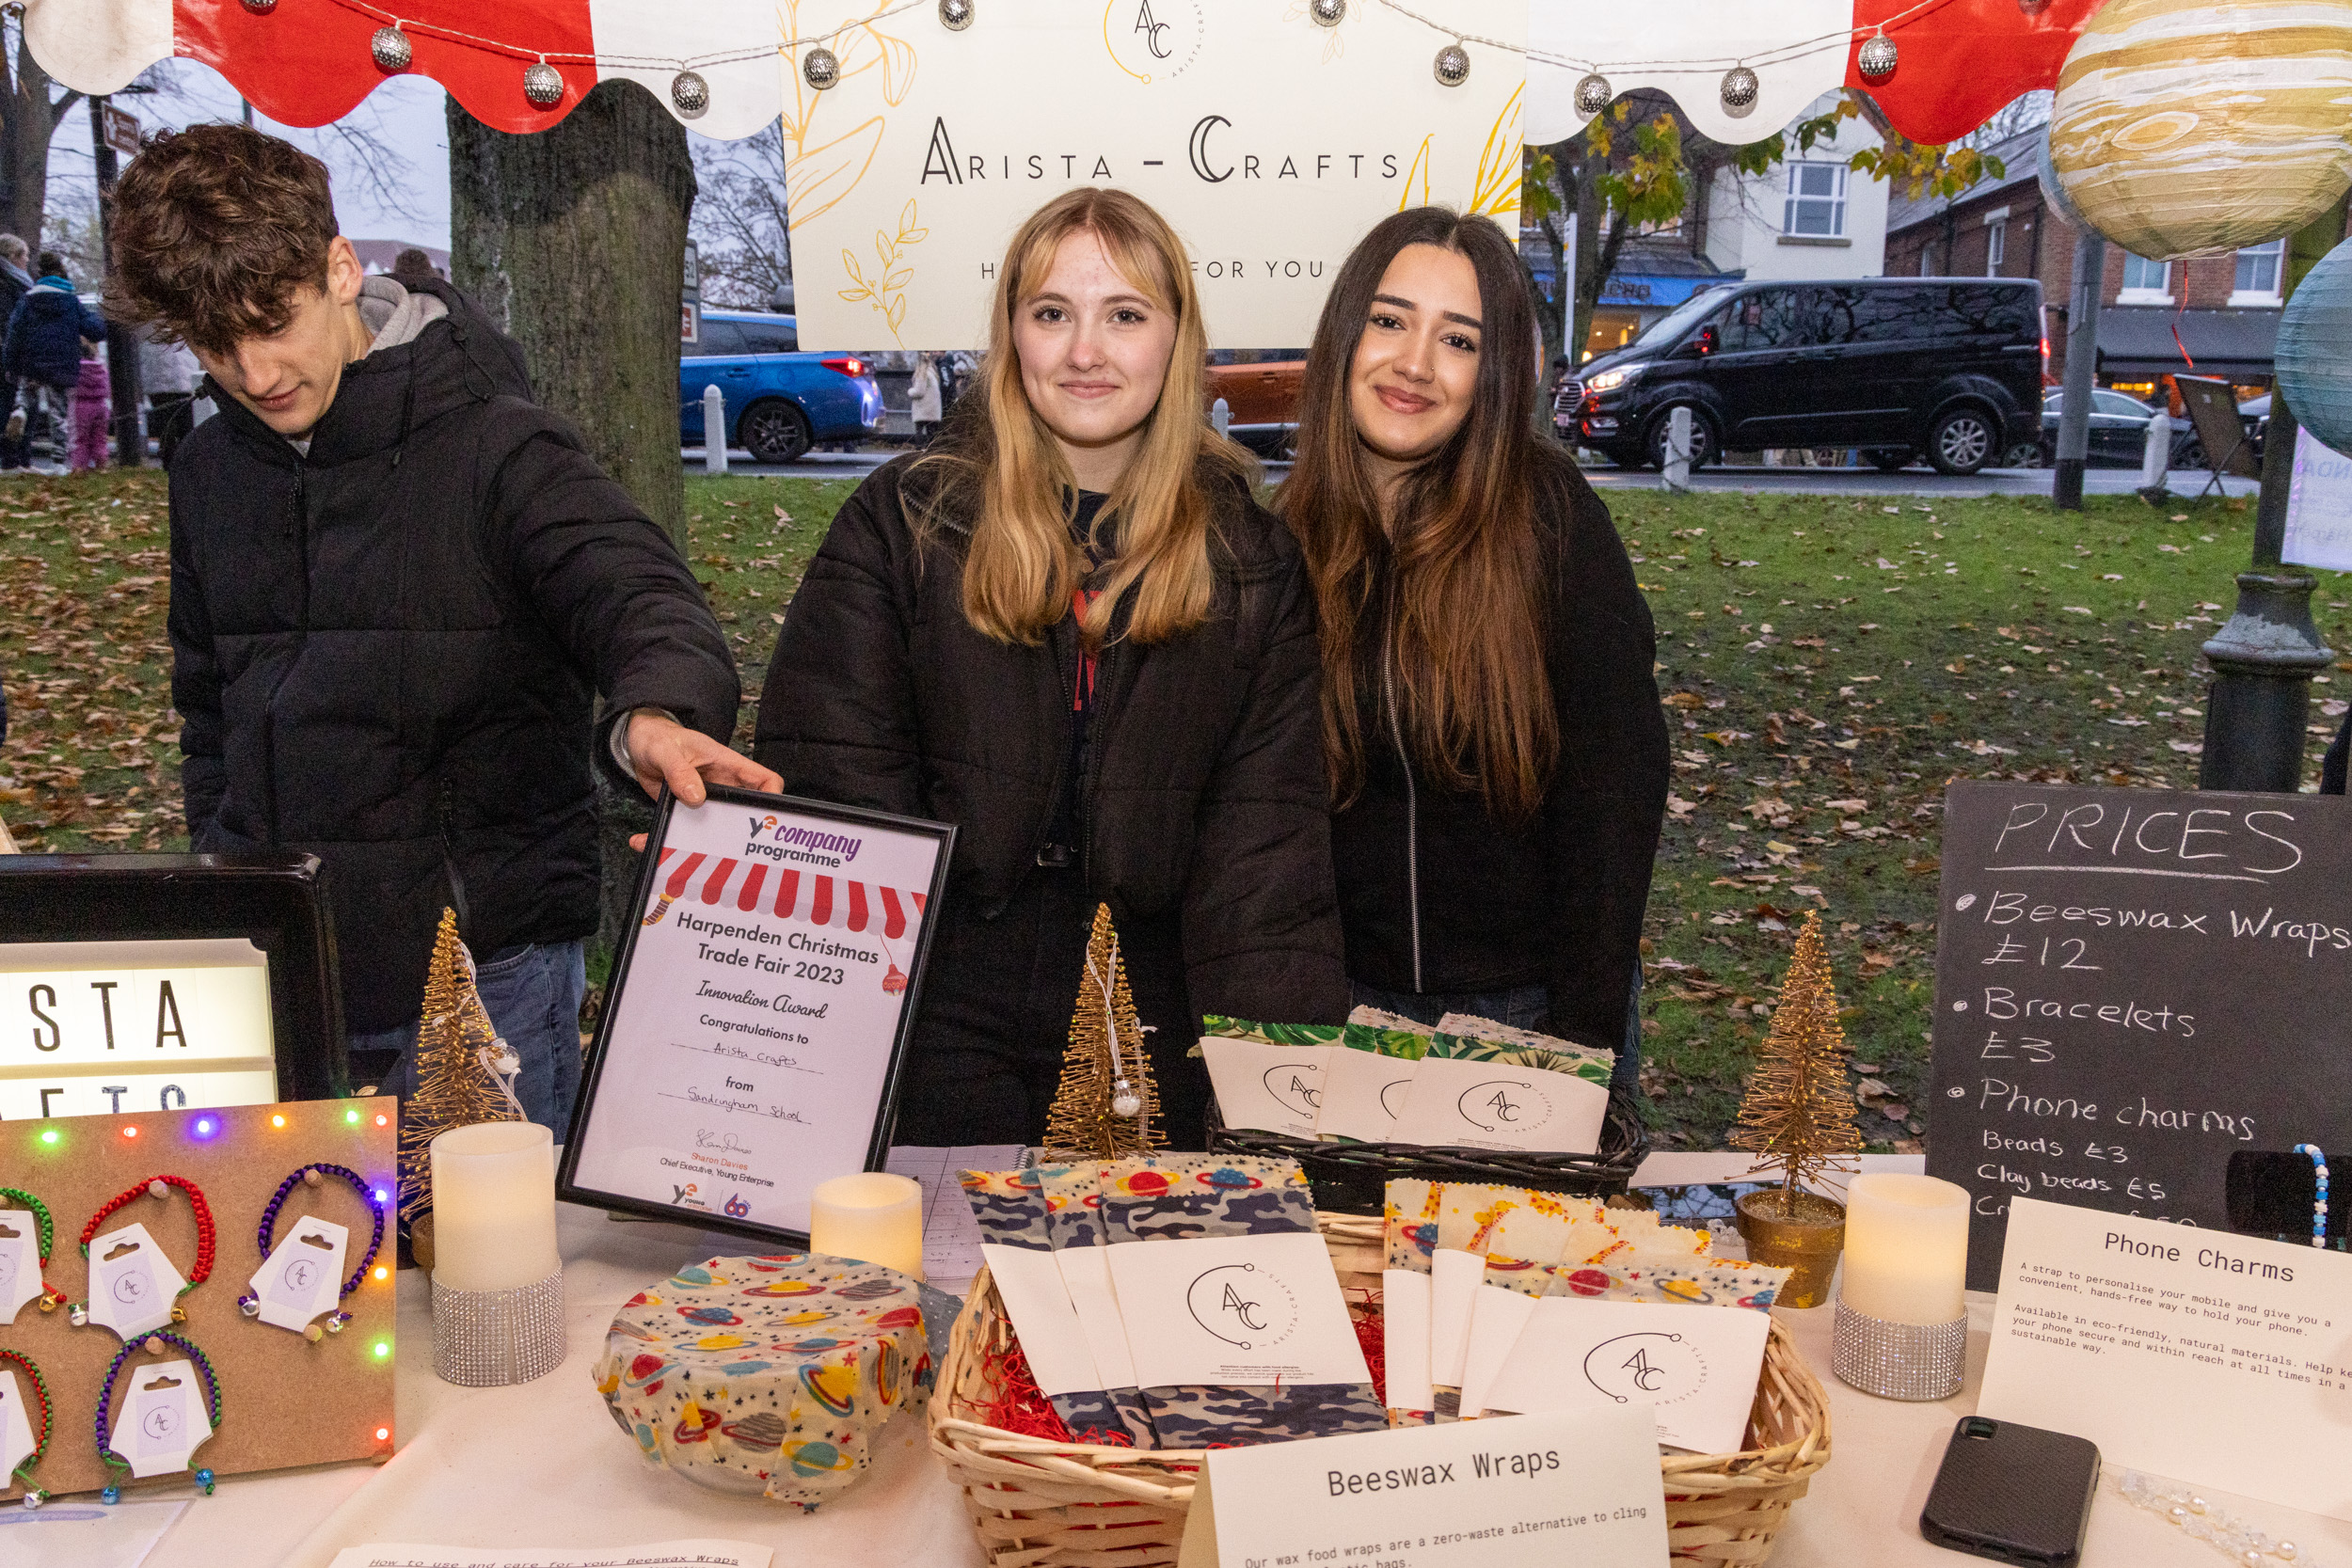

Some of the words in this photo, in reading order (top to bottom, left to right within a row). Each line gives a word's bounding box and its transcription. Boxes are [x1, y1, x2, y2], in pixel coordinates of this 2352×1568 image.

[1171, 0, 1204, 78] ARISTA-CRAF
[919, 116, 1112, 184] ARISTA
[1188, 115, 1398, 183] CRAFTS
[1265, 261, 1323, 278] YOU
[745, 842, 841, 868] programme
[774, 825, 862, 862] company
[1995, 802, 2302, 873] PRICES
[676, 911, 782, 945] Harpenden
[788, 932, 879, 964] Christmas
[1983, 891, 2207, 935] Beeswax
[2230, 908, 2352, 958] Wraps
[698, 943, 749, 967] Trade
[755, 953, 790, 974] Fair
[794, 961, 844, 985] 2023
[1980, 934, 2103, 971] £12
[28, 980, 187, 1052] STA
[695, 980, 769, 1008] Innovation
[772, 994, 829, 1019] Award
[1984, 987, 2195, 1037] Bracelets
[699, 1014, 794, 1042] Congratulations
[797, 1033, 809, 1044] to
[1980, 1031, 2056, 1063] £3
[713, 1042, 748, 1058] Arista
[756, 1053, 797, 1067] Crafts
[725, 1076, 755, 1092] from
[770, 1105, 803, 1122] School
[1979, 1078, 2098, 1121] Phone
[2117, 1097, 2255, 1140] charms
[691, 1152, 720, 1165] Sharon
[721, 1158, 748, 1171] Davies
[1983, 1129, 2063, 1156] Beads
[2085, 1142, 2128, 1163] £3
[660, 1157, 679, 1168] Chief
[679, 1162, 714, 1177] Executive,
[716, 1168, 739, 1182] Young
[739, 1174, 774, 1188] Enterprise
[1977, 1164, 2030, 1193] Clay
[2042, 1172, 2112, 1192] beads
[2126, 1177, 2166, 1200] £5
[723, 1193, 749, 1218] 60
[2105, 1232, 2181, 1262] Phone
[2198, 1248, 2294, 1282] Charms
[2019, 1275, 2083, 1294] convenient,
[2090, 1287, 2153, 1307] hands-free
[2158, 1301, 2178, 1312] way
[2185, 1306, 2197, 1315] to
[2203, 1308, 2230, 1322] hold
[2235, 1317, 2262, 1327] your
[2268, 1322, 2308, 1337] phone.
[2032, 1264, 2062, 1277] strap
[2069, 1271, 2080, 1280] to
[2086, 1274, 2154, 1294] personalise
[2160, 1289, 2185, 1300] your
[2191, 1294, 2231, 1308] mobile
[2237, 1303, 2257, 1313] and
[2264, 1307, 2291, 1320] give
[2297, 1315, 2317, 1326] you
[2010, 1328, 2076, 1348] sustainable
[2082, 1343, 2106, 1354] way.
[2012, 1317, 2037, 1328] your
[2042, 1323, 2073, 1335] phone
[2078, 1330, 2116, 1344] secure
[2122, 1338, 2140, 1348] and
[2146, 1344, 2185, 1358] within
[2192, 1352, 2224, 1365] reach
[2231, 1359, 2243, 1370] at
[2249, 1364, 2269, 1375] all
[2278, 1369, 2311, 1383] times
[2318, 1378, 2332, 1387] in
[2014, 1304, 2069, 1321] Available
[2074, 1316, 2087, 1325] in
[2092, 1321, 2171, 1343] eco-friendly,
[2180, 1337, 2225, 1353] natural
[2232, 1347, 2297, 1367] materials.
[2305, 1361, 2333, 1375] Help
[1327, 1459, 1455, 1497] Beeswax
[1472, 1449, 1562, 1480] Wraps
[1245, 1557, 1267, 1568] Our
[1276, 1554, 1299, 1566] wax
[1308, 1546, 1337, 1562] food
[1343, 1544, 1382, 1557] wraps
[1390, 1539, 1411, 1551] are
[1419, 1538, 1426, 1546] a
[1433, 1526, 1505, 1545] zero-waste
[1511, 1514, 1587, 1535] alternative
[1594, 1513, 1607, 1523] to
[1613, 1507, 1647, 1520] cling
[370, 1559, 399, 1567] How
[583, 1560, 617, 1568] your
[627, 1556, 688, 1565] Beeswax
[696, 1555, 739, 1566] Wraps
